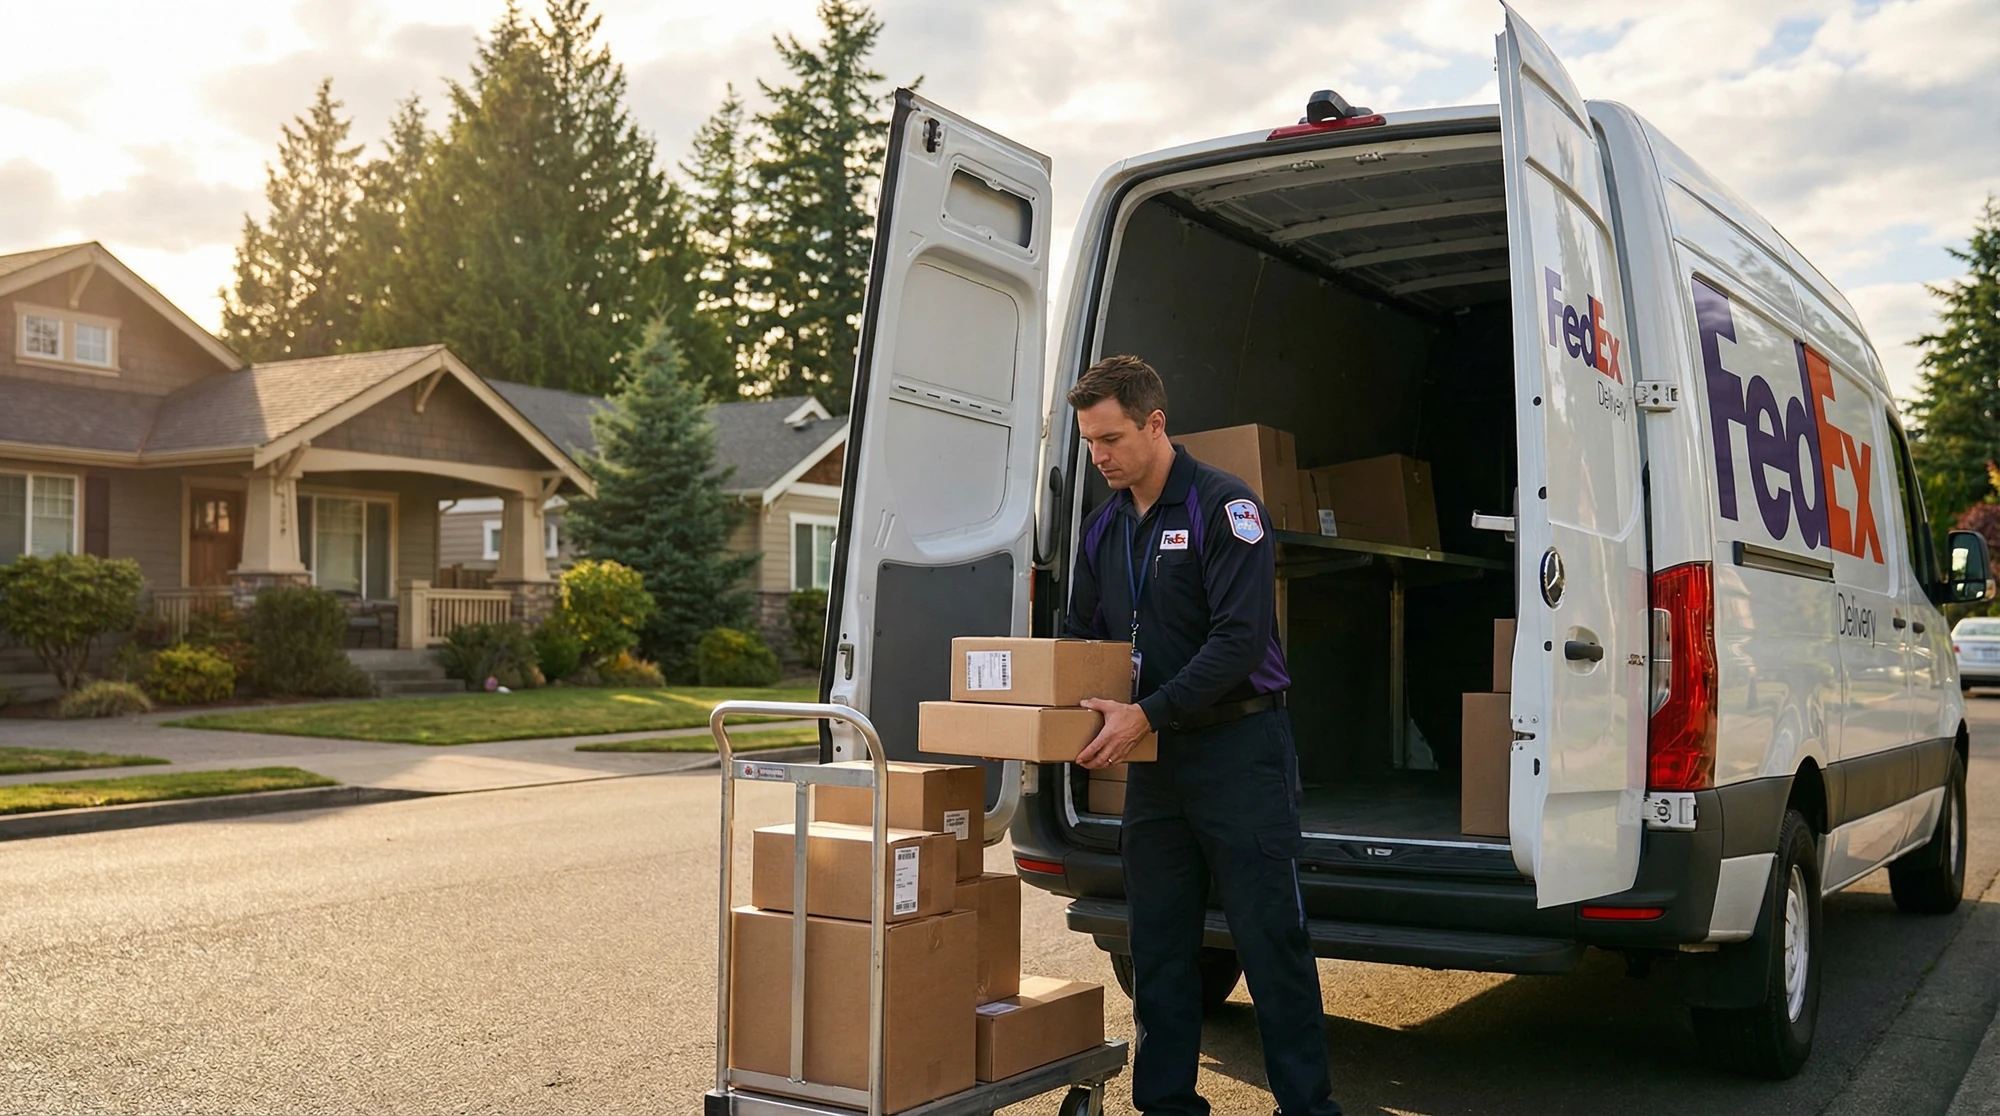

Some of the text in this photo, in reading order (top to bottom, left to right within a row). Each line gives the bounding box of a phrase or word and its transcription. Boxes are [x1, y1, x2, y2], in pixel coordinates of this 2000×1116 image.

[1545, 266, 1624, 386] FedEx
[1691, 272, 1885, 566] FedEx
[1838, 592, 1877, 649] Delivery
